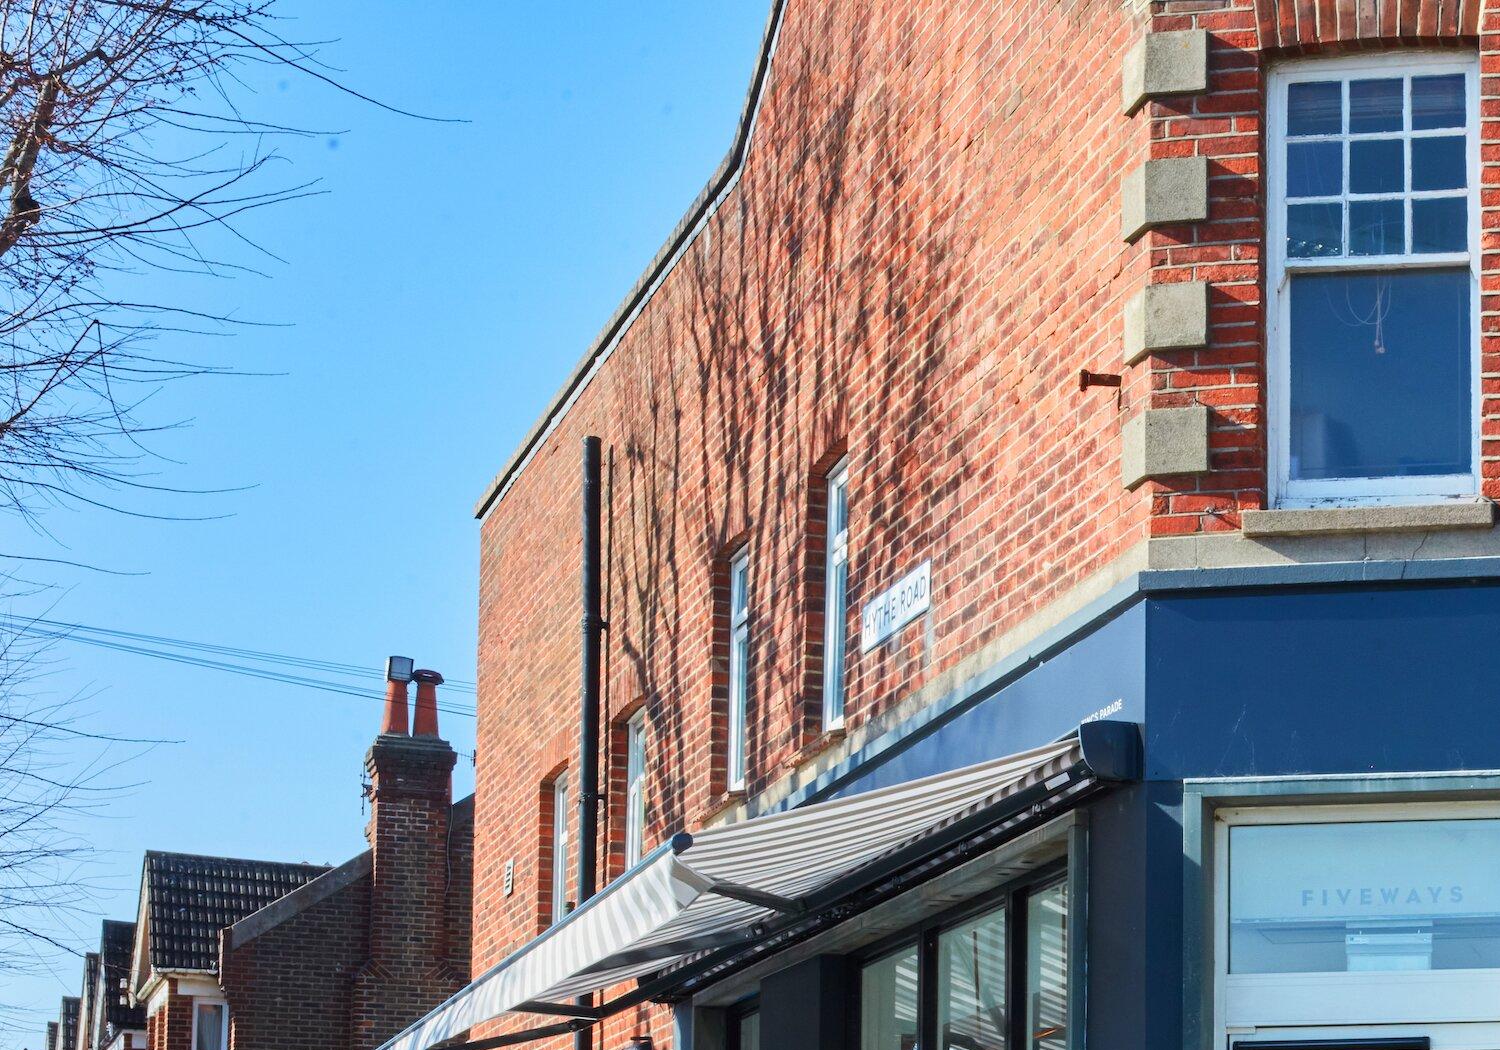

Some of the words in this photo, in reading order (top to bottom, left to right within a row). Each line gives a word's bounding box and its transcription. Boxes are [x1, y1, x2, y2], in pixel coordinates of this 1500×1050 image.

[865, 597, 896, 640] HYTHE
[900, 575, 927, 612] ROAD
[1099, 699, 1122, 720] PARADE
[1301, 885, 1464, 907] FIVEWAYS
